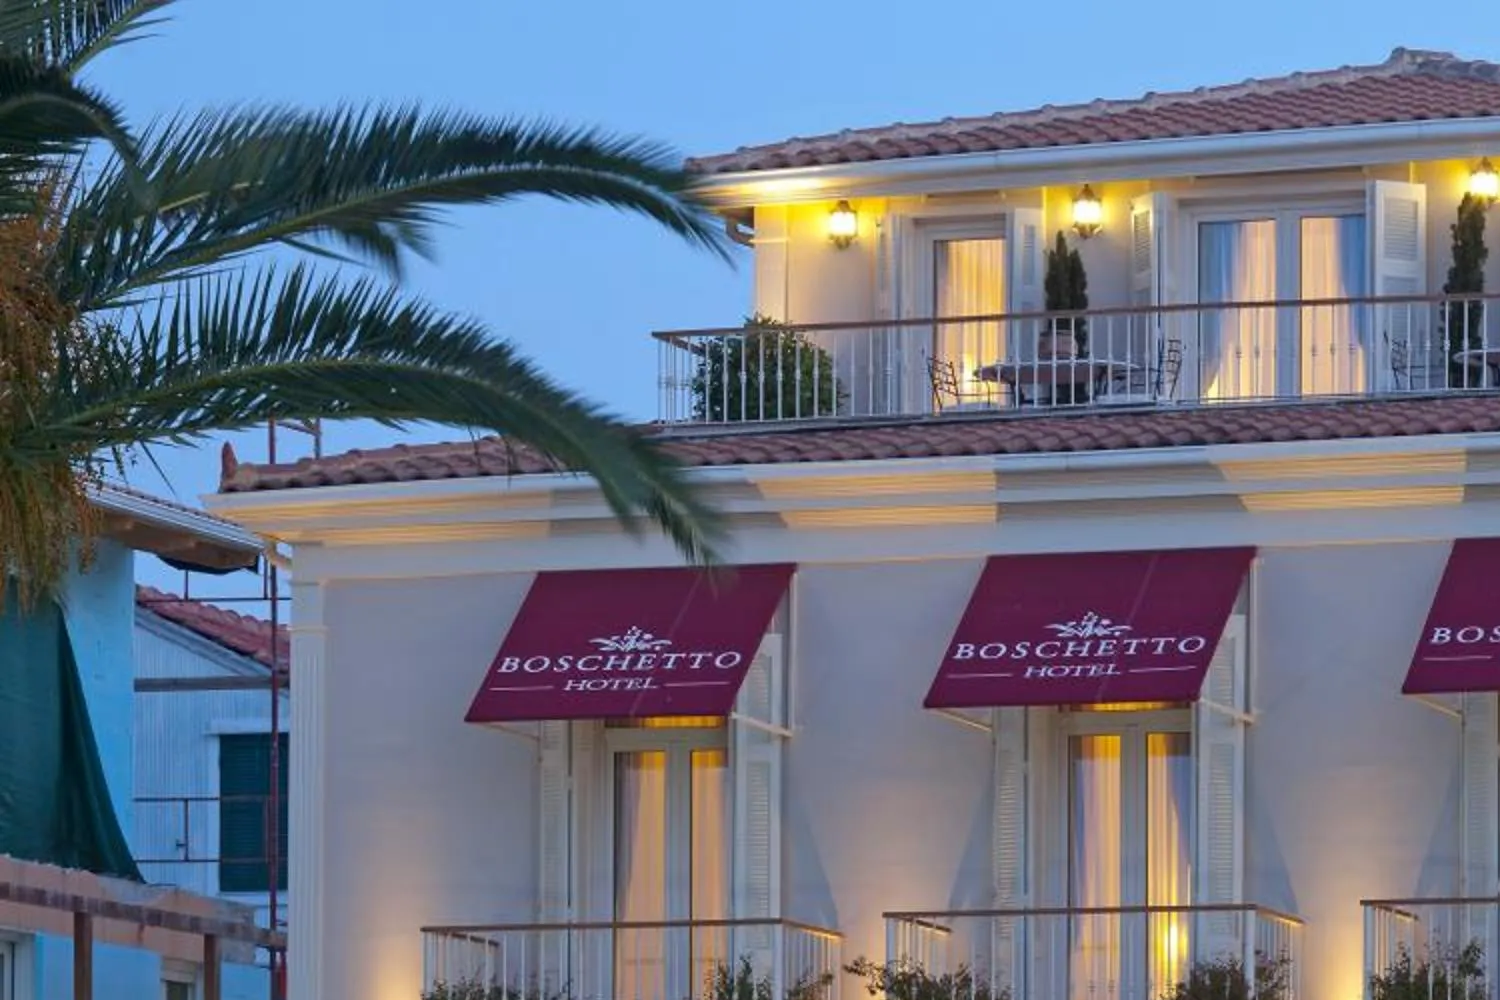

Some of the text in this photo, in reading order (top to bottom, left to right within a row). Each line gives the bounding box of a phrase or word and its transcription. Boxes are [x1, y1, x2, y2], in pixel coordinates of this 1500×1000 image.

[953, 636, 1205, 660] BOSCHETTO
[498, 651, 741, 673] BOSCHETTO
[1023, 663, 1121, 679] HOTEL
[564, 677, 658, 691] HOTEL
